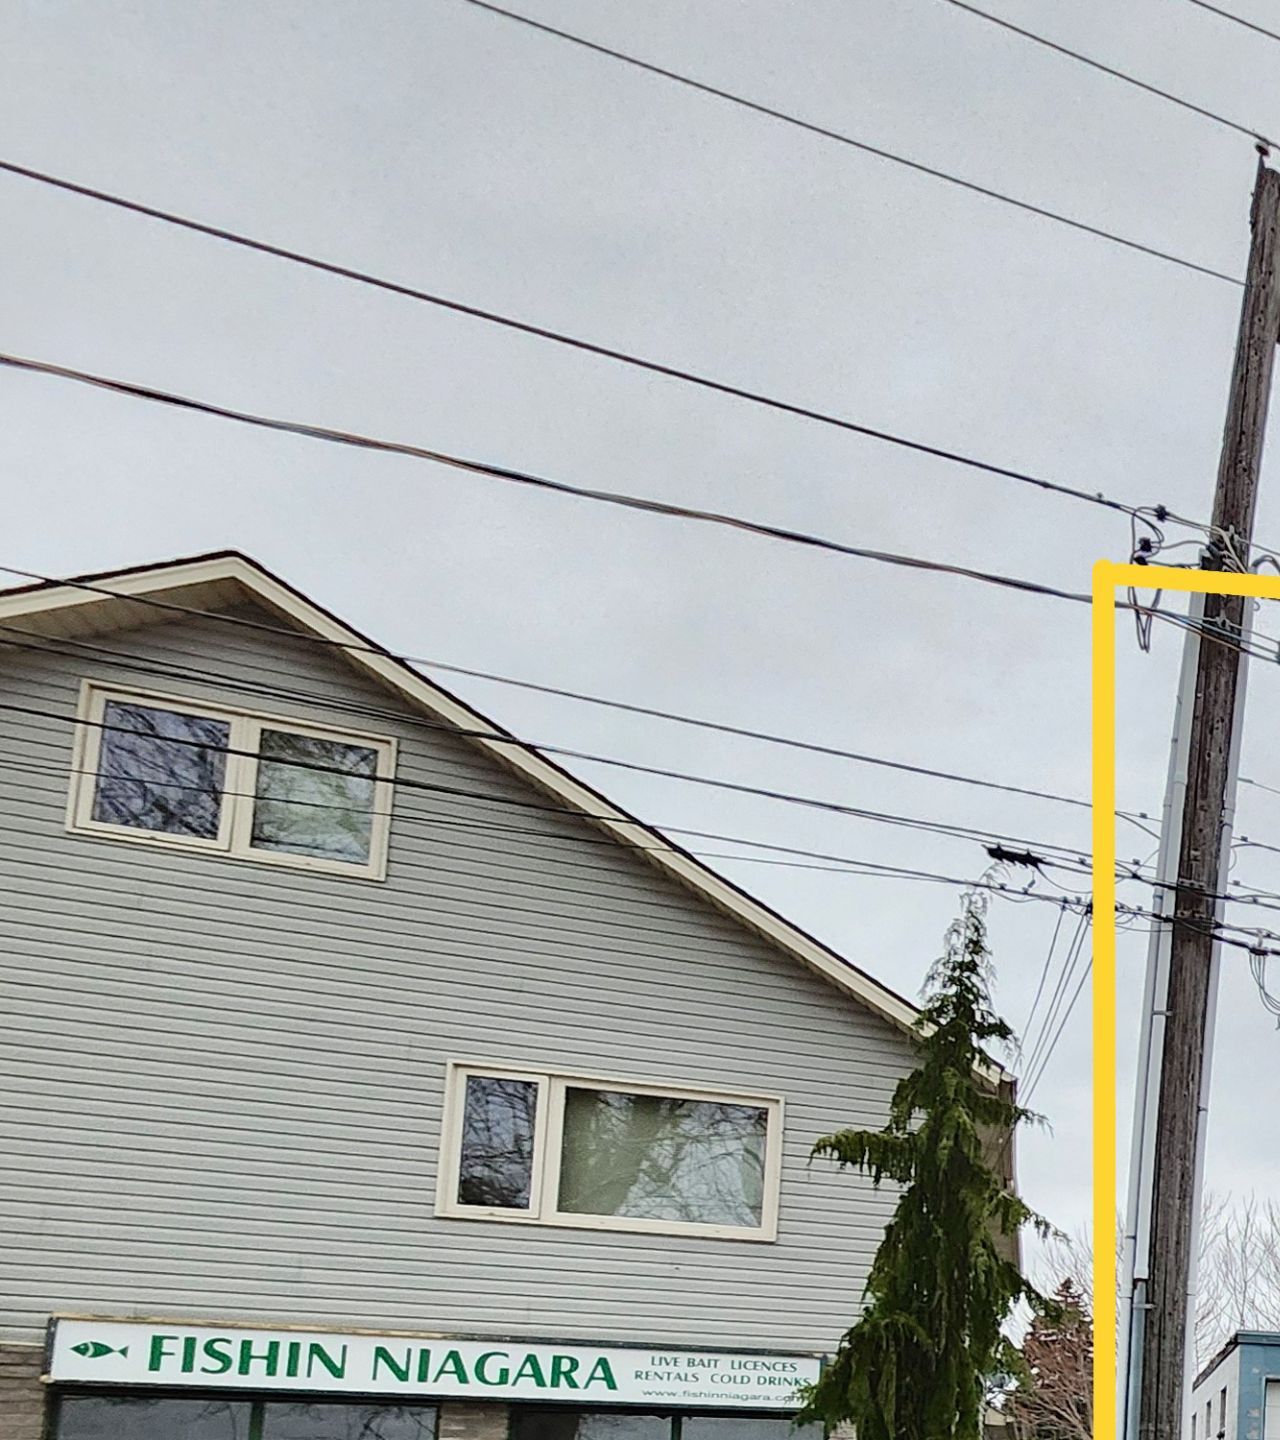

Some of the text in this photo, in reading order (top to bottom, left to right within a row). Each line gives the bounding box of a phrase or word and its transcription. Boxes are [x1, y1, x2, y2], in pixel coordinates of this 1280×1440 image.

[148, 1335, 618, 1391] FISHIN NIAGARA
[650, 1356, 798, 1373] LIVE BAIT LICENCES
[634, 1370, 812, 1387] RENTALS COLD DRINKS
